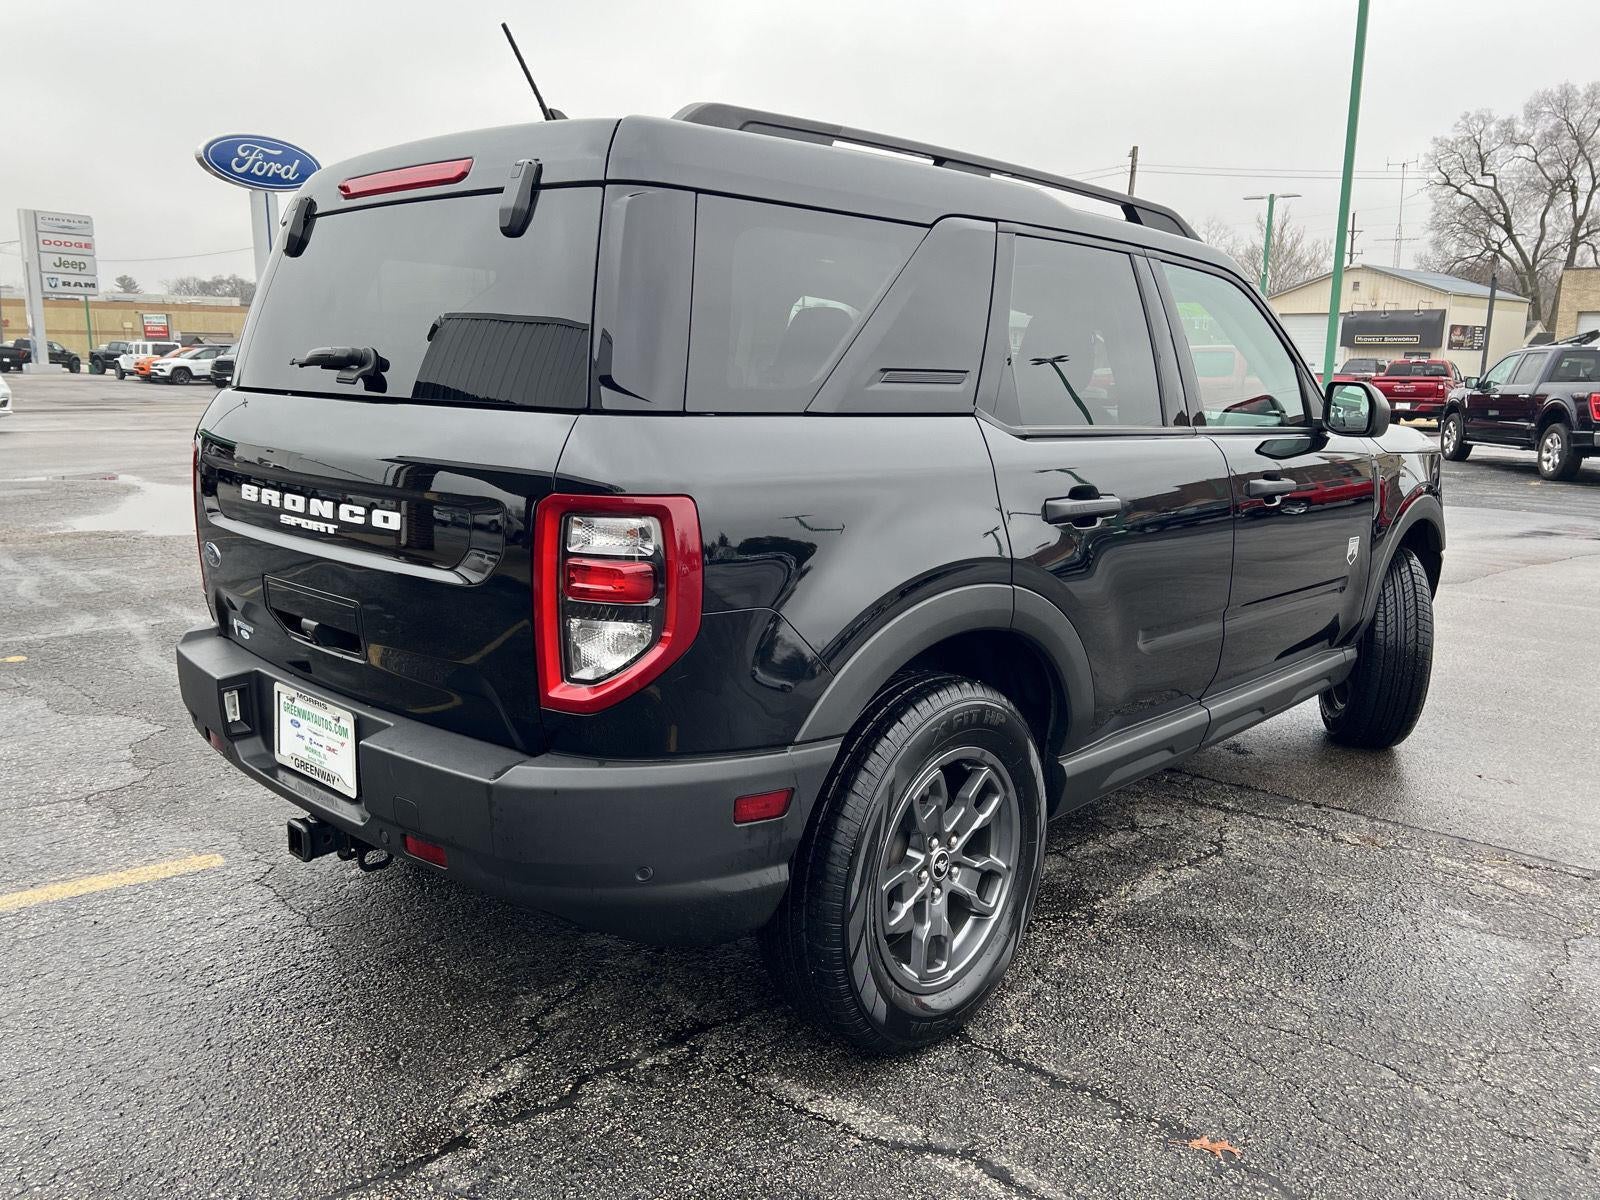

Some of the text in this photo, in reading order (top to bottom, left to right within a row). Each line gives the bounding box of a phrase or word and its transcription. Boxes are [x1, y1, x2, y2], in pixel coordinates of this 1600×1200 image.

[231, 143, 300, 180] Ford
[41, 216, 89, 224] CHRYSLER
[42, 239, 92, 249] DODGE
[53, 257, 87, 272] Jeep
[62, 280, 96, 288] RAM
[241, 483, 401, 531] BRONCO
[279, 513, 339, 534] SPORT
[296, 692, 328, 710] MORRIS
[283, 701, 349, 739] GREENWAYAUTOS.COM
[294, 757, 336, 785] GREENWAY
